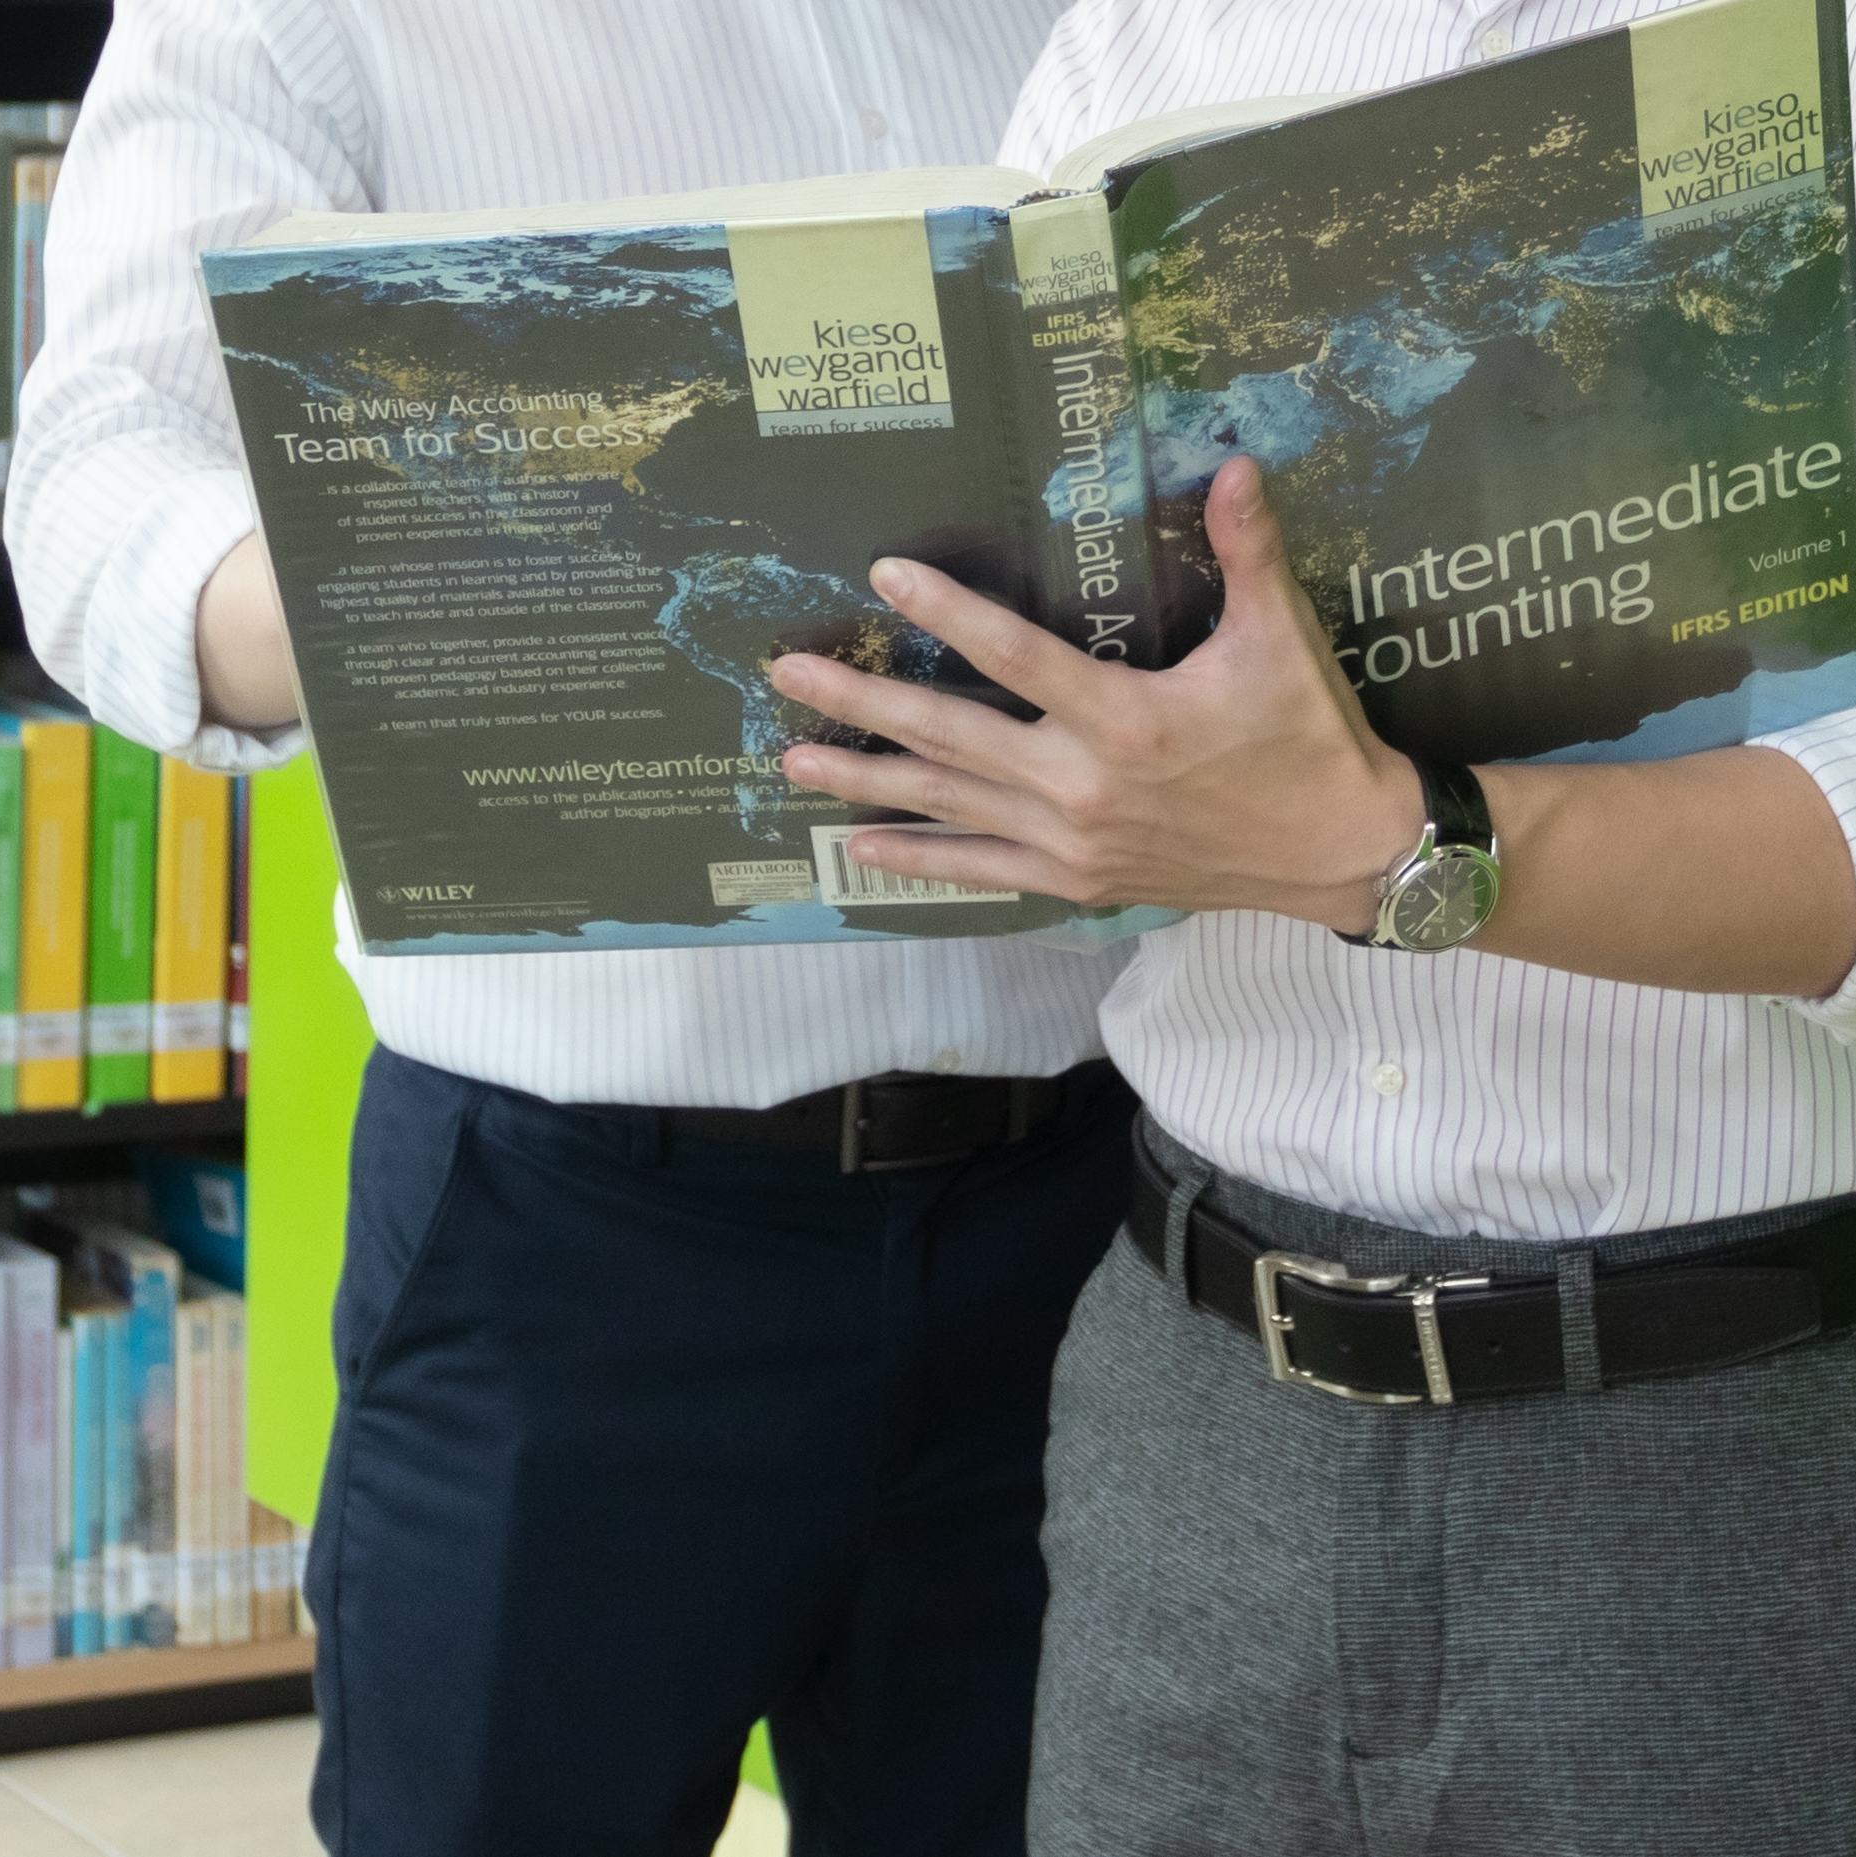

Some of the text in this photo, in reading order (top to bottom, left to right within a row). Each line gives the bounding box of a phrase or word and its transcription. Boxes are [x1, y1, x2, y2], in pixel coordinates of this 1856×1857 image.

[1704, 93, 1798, 138] kieso
[1641, 110, 1820, 182] weygandt
[1665, 144, 1806, 209] warfield
[1655, 185, 1815, 239] team for success
[1051, 251, 1101, 272] kieso
[1020, 260, 1113, 291] weygandt
[1032, 277, 1107, 305] warfield
[1047, 311, 1086, 329] IFRS
[814, 320, 916, 349] kieso
[1032, 322, 1105, 347] EDITION
[750, 342, 943, 382] weygandt
[778, 375, 930, 411] warfield
[300, 389, 604, 424] The Wiley Accounting
[771, 417, 942, 436] team for success
[274, 422, 643, 464] Team for Success
[354, 480, 441, 493] collaborative
[446, 478, 480, 488] team
[485, 476, 499, 486] of
[562, 472, 592, 482] who
[597, 471, 620, 480] are
[363, 497, 417, 510] inspired
[488, 492, 517, 502] with
[533, 489, 580, 500] history
[1053, 349, 1135, 665] Intermediate Ac
[338, 503, 612, 527] of student success in the classroom and
[356, 531, 402, 544] proven
[407, 527, 483, 542] experience
[487, 524, 500, 535] in
[530, 521, 555, 533] real
[1348, 441, 1842, 625] Intermediate
[351, 565, 386, 575] team
[390, 562, 434, 573] whose
[438, 558, 489, 570] mission
[494, 557, 503, 568] is
[508, 557, 521, 567] to
[525, 555, 563, 566] foster
[568, 552, 623, 564] success
[625, 551, 641, 562] by
[1749, 530, 1846, 572] Volume 1
[317, 566, 661, 594] engaging students in learning and by providing the
[320, 582, 663, 610] highest quality of materials available to instructors
[1671, 574, 1849, 644] IFRS EDITION
[345, 613, 359, 623] to
[363, 611, 401, 622] teach
[405, 609, 443, 620] inside
[449, 607, 474, 618] and
[478, 604, 527, 616] outside
[532, 603, 545, 614] of
[550, 602, 572, 613] the
[359, 644, 393, 654] team
[397, 642, 426, 652] who
[493, 635, 543, 649] provide
[547, 636, 555, 644] a
[559, 631, 629, 644] consistent
[631, 630, 666, 640] voice
[345, 645, 665, 671] through clear and current accounting examples
[352, 661, 665, 686] and proven pedagogy based on their collective
[395, 688, 460, 699] academic
[464, 685, 488, 696] and
[493, 682, 546, 694] industry
[391, 720, 426, 731] team
[430, 718, 457, 728] that
[461, 716, 491, 728] truly
[494, 713, 537, 725] strives
[541, 712, 559, 723] for
[563, 709, 606, 722] YOUR
[463, 754, 783, 786] www.wileyteamforsuc
[478, 796, 529, 808] access
[533, 794, 548, 805] to
[553, 793, 578, 804] the
[583, 788, 673, 804] publications
[688, 786, 729, 798] video
[560, 806, 609, 821] author
[614, 802, 702, 820] biographies
[773, 799, 848, 812] interviews
[714, 863, 808, 875] ARTHABOOK
[401, 885, 475, 901] WILEY
